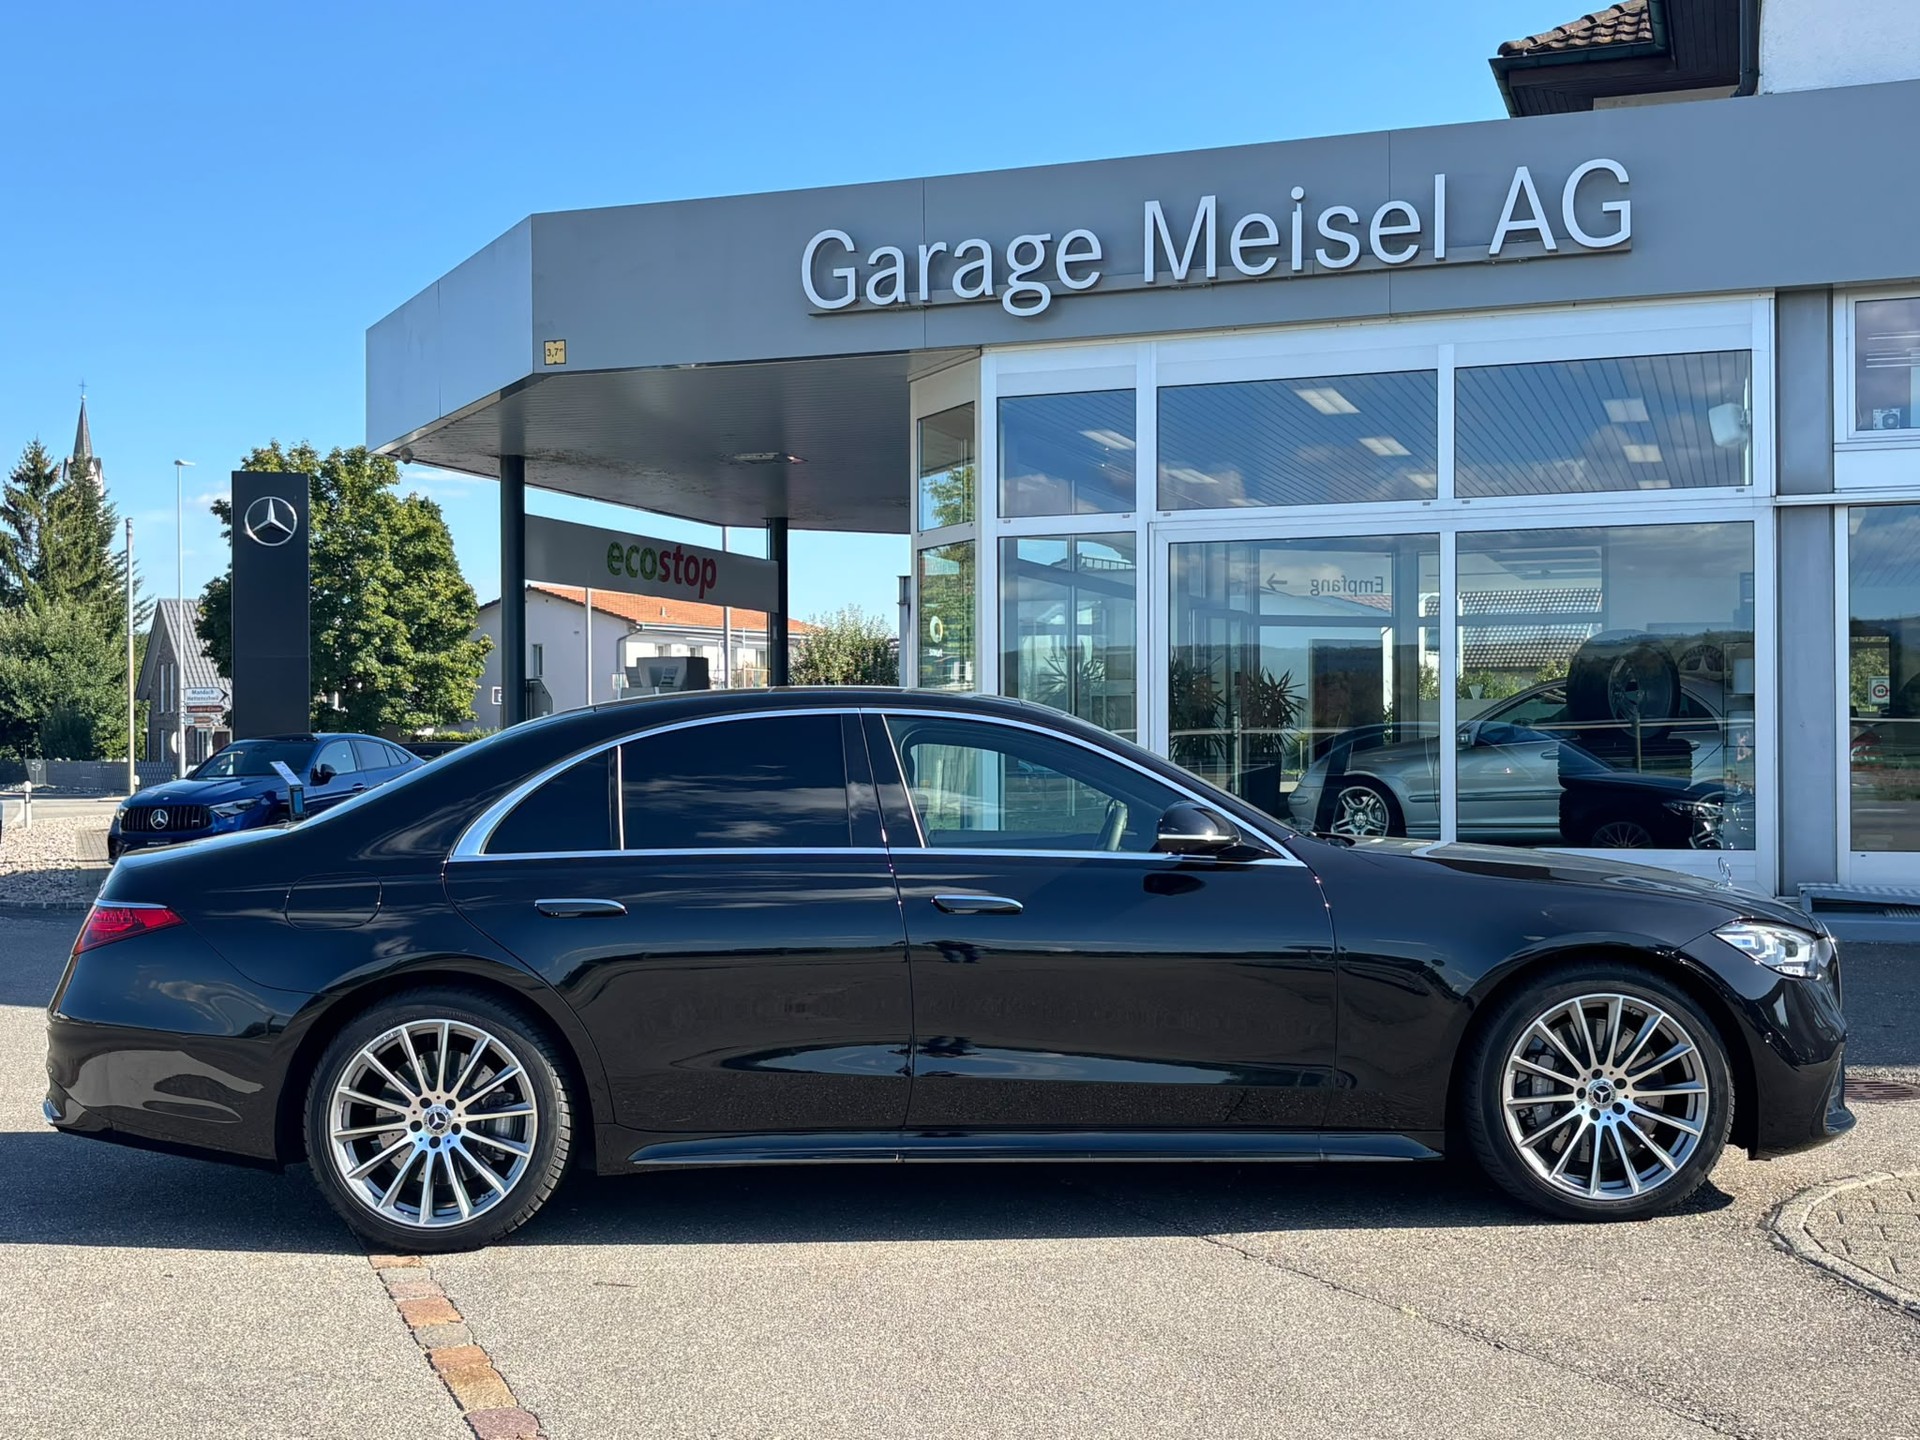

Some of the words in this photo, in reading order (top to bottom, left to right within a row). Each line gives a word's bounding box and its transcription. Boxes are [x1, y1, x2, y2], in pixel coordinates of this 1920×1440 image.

[801, 228, 1102, 317] Garage
[1143, 172, 1446, 284] Meisel
[1488, 158, 1632, 255] AG
[606, 541, 717, 599] ecostop
